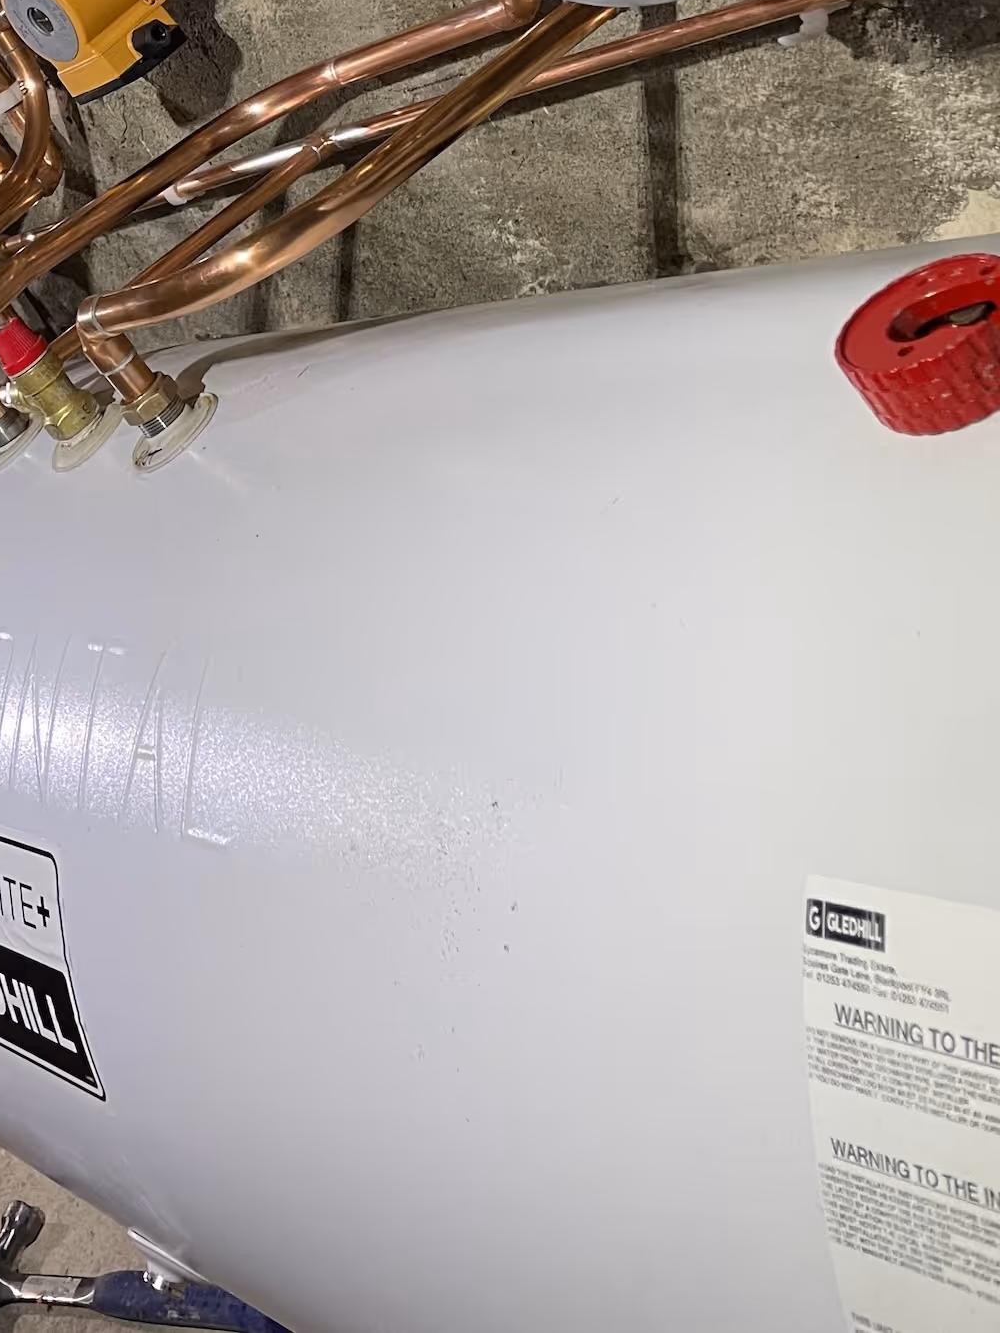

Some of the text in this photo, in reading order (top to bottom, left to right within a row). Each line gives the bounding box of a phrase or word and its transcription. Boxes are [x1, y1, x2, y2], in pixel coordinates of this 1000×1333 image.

[827, 912, 882, 943] GLEDHILL
[834, 1002, 924, 1045] WARNING
[929, 1027, 956, 1054] TO
[961, 1035, 1000, 1066] THE
[830, 1137, 910, 1179] WARNING
[913, 1164, 939, 1189] TO
[943, 1174, 979, 1204] THE
